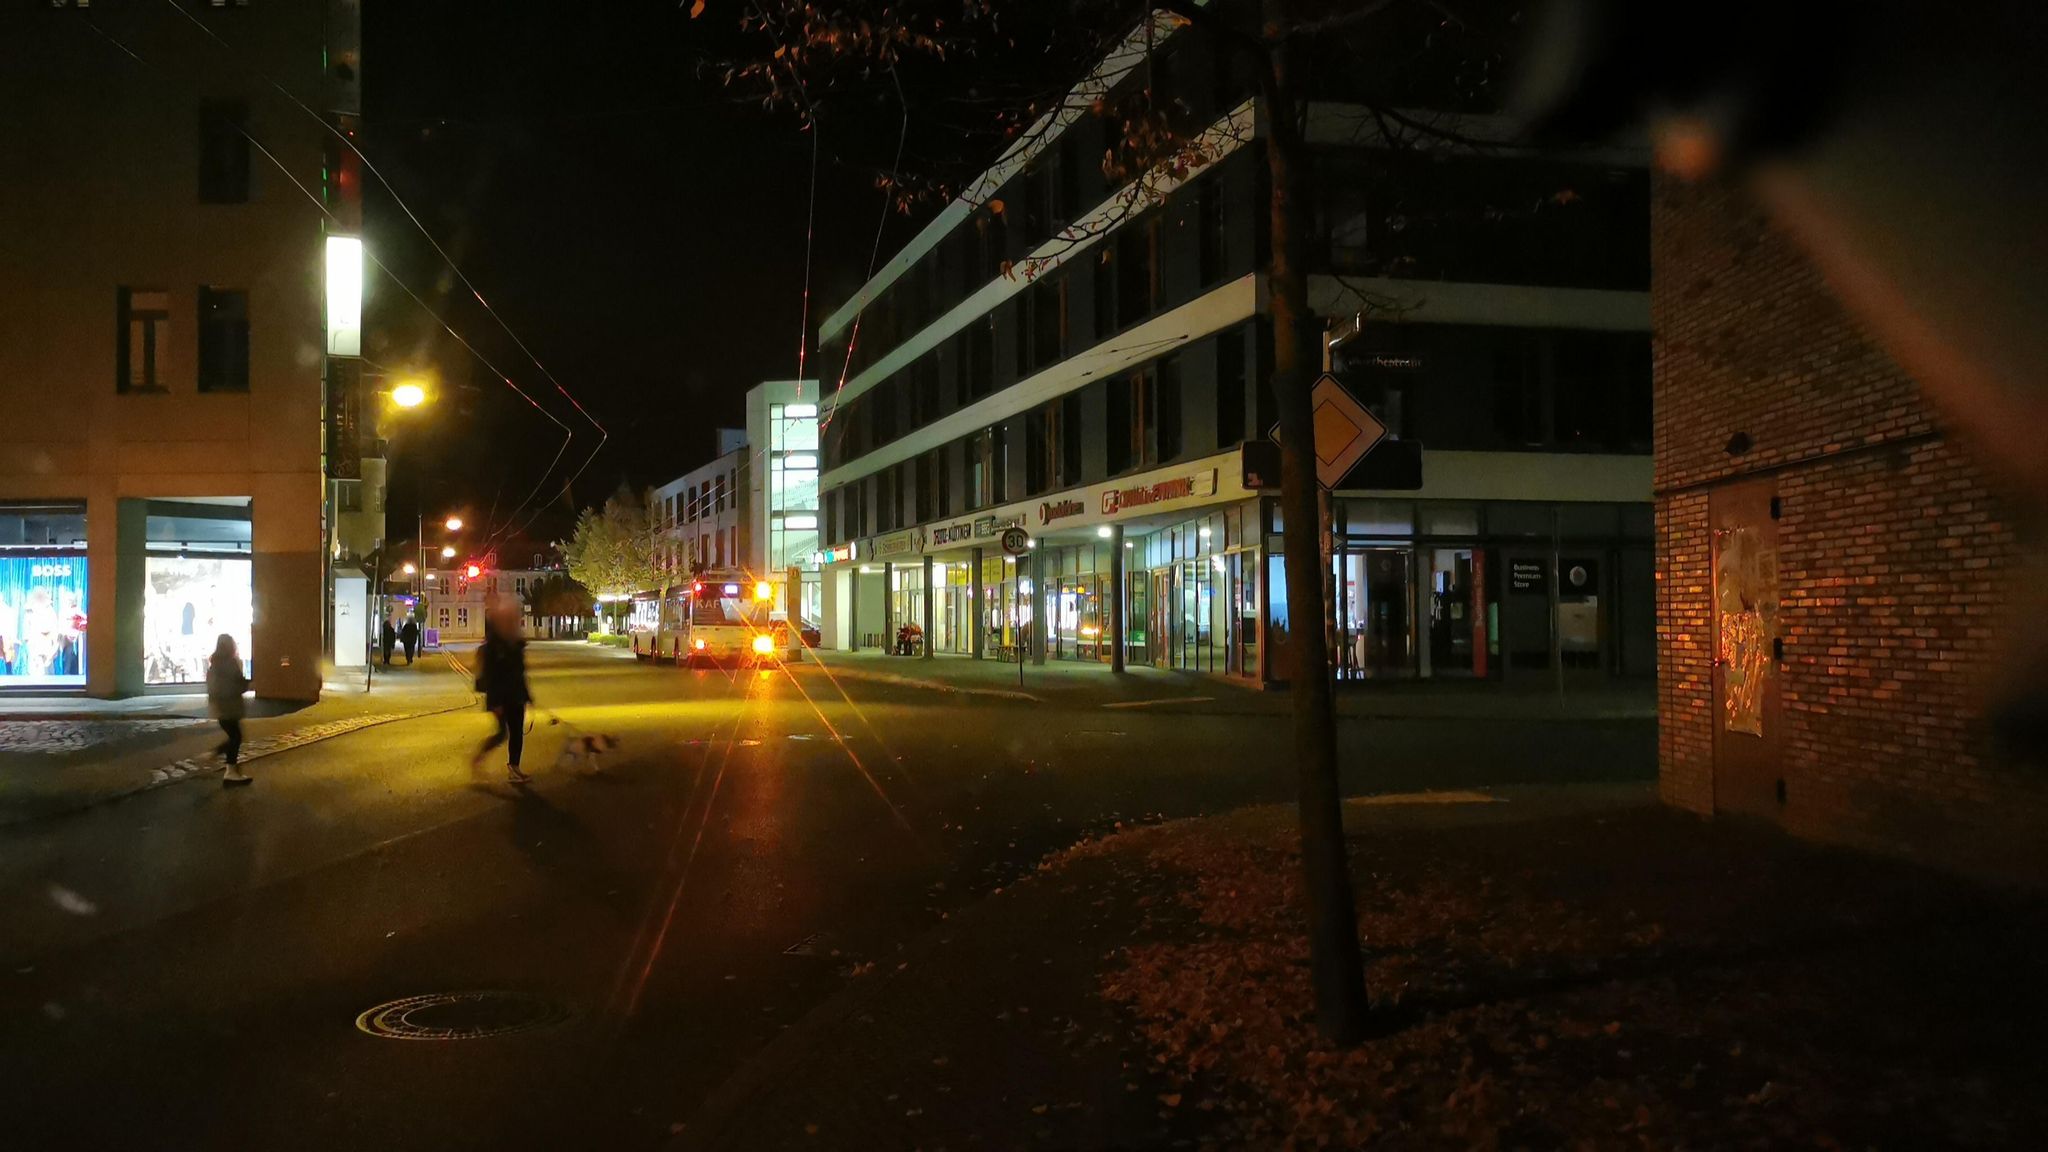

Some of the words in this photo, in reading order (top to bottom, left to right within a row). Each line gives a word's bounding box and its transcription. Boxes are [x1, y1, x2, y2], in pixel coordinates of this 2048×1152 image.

[1008, 535, 1023, 548] 30
[32, 565, 72, 577] BOSS
[1513, 563, 1540, 572] Business
[1513, 572, 1542, 580] Premium
[1513, 580, 1530, 589] Store
